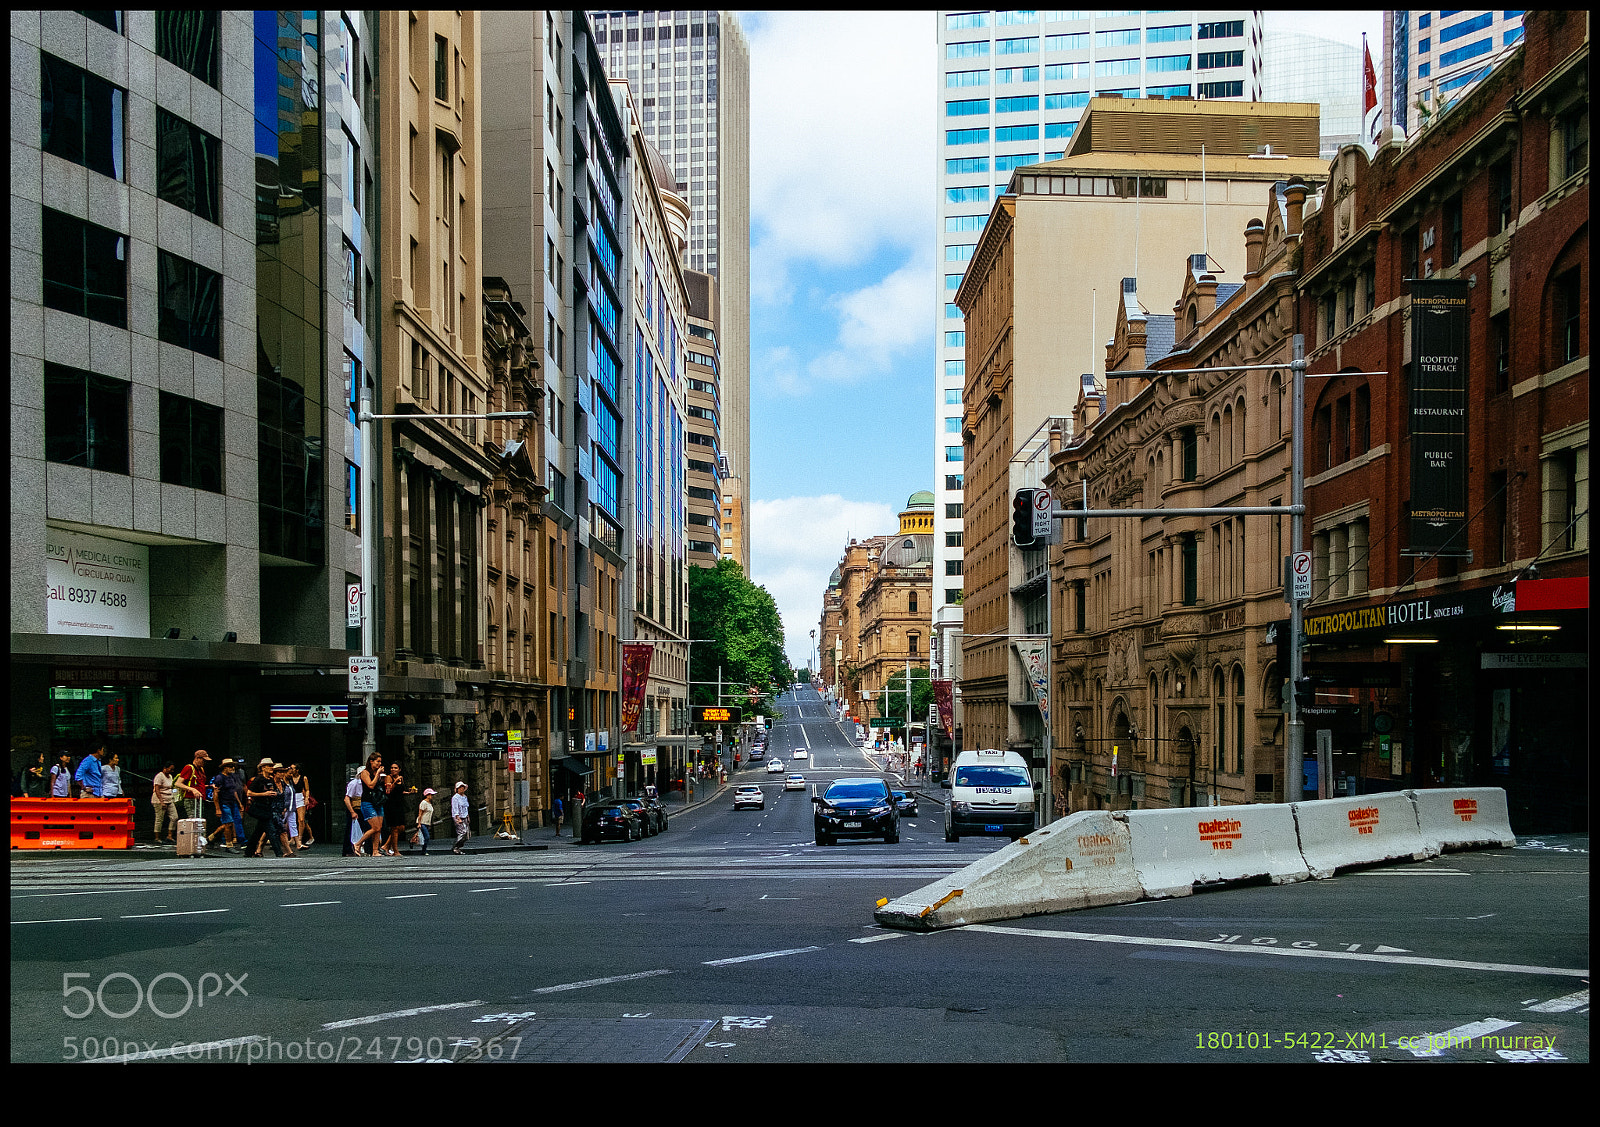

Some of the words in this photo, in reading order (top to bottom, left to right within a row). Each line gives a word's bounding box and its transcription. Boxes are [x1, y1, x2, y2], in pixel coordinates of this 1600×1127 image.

[1420, 356, 1459, 364] ROOFTOP
[76, 549, 111, 564] MEDICAL
[113, 556, 142, 569] CENTRE
[78, 568, 114, 580] CIRCULAR
[116, 574, 136, 584] QUAY
[68, 587, 97, 603] 8937
[100, 592, 127, 608] 4588
[1304, 606, 1386, 636] METROPOLITAN
[1388, 600, 1432, 624] HOTEL
[1434, 607, 1450, 618] SINCE
